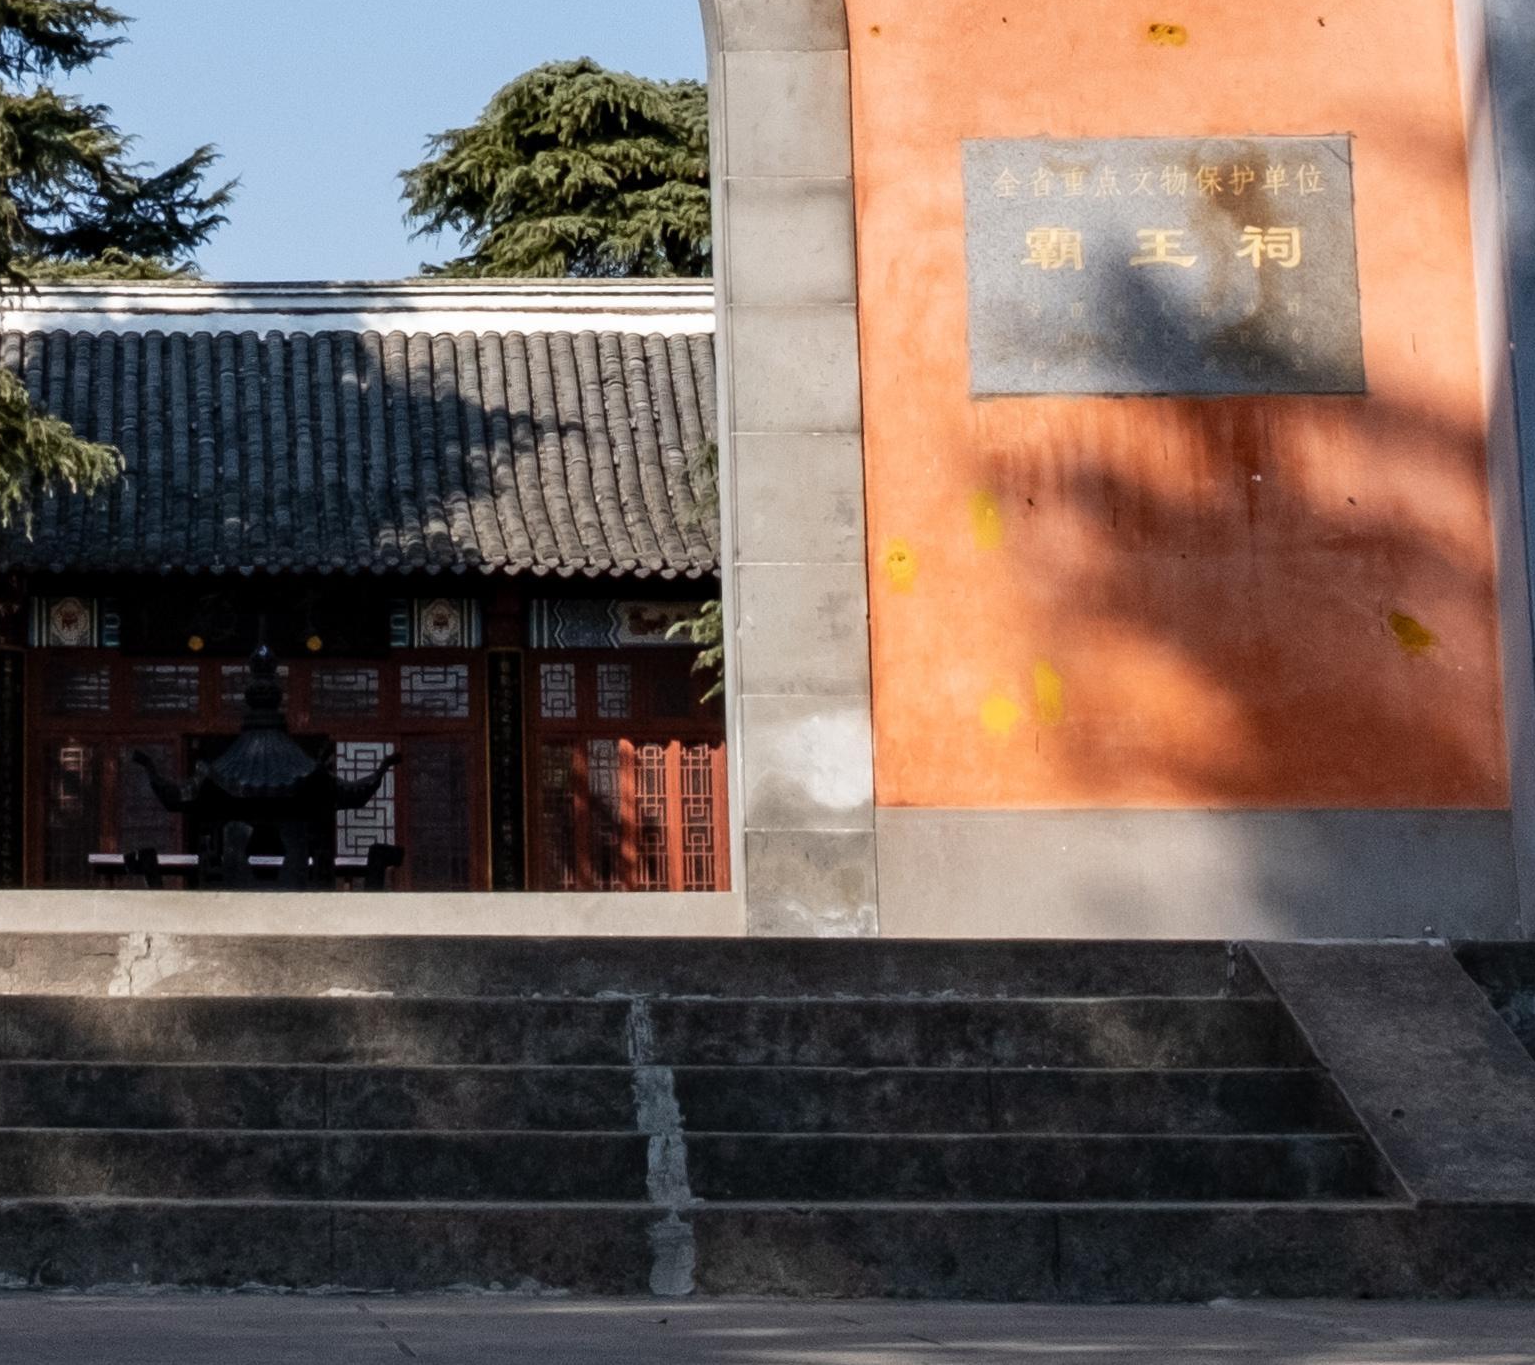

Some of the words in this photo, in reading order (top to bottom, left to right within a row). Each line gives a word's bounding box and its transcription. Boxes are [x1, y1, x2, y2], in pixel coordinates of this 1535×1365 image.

[992, 163, 1326, 199] 全省重点文物保护单位
[1021, 225, 1303, 271] 霸王祠
